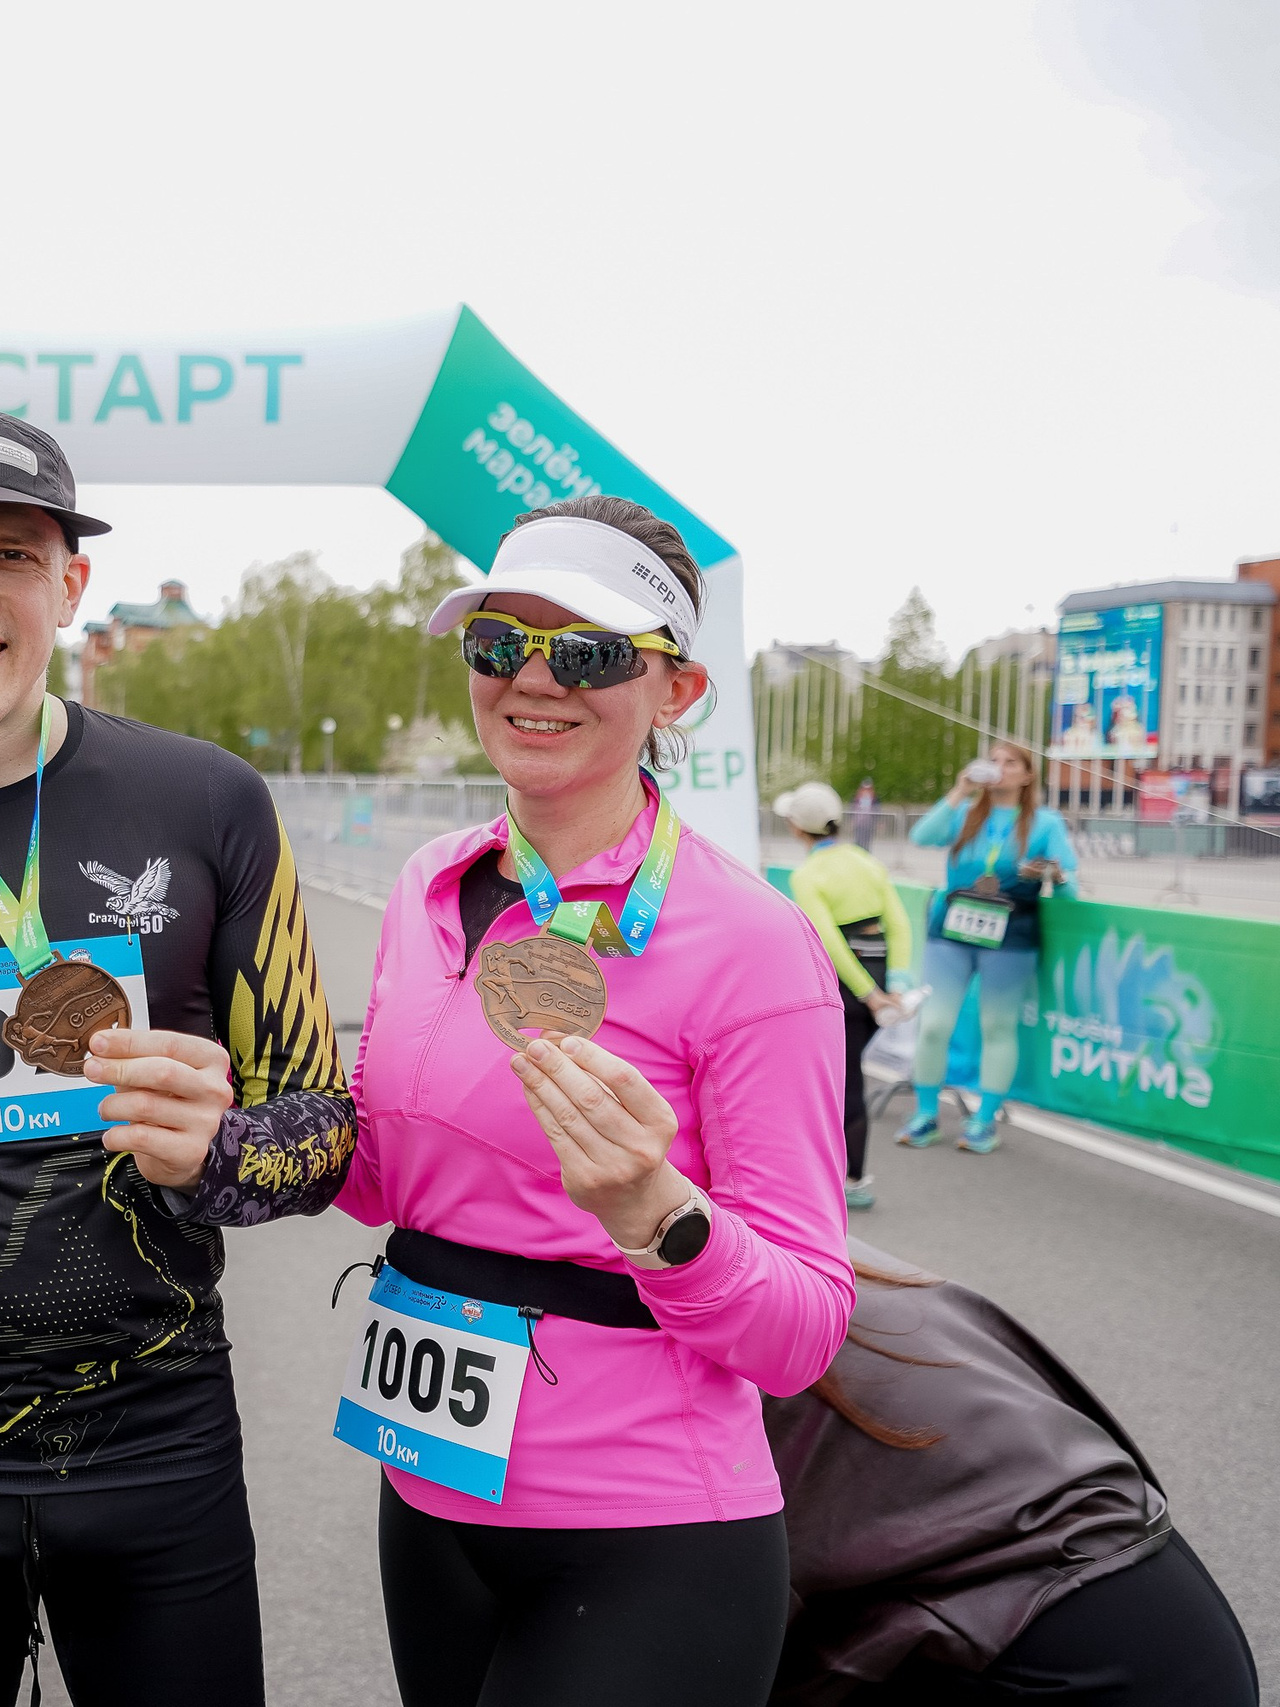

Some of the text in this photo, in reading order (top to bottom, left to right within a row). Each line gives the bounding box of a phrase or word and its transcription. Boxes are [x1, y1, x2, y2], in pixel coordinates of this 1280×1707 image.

[462, 427, 558, 510] мара
[648, 574, 676, 605] cep
[140, 914, 164, 935] 50
[629, 921, 646, 939] Utair
[84, 993, 114, 1018] СБЕР
[556, 1000, 591, 1018] СБЕР
[388, 1283, 401, 1296] СБЕР
[361, 1319, 497, 1428] 1005
[377, 1425, 397, 1456] 10
